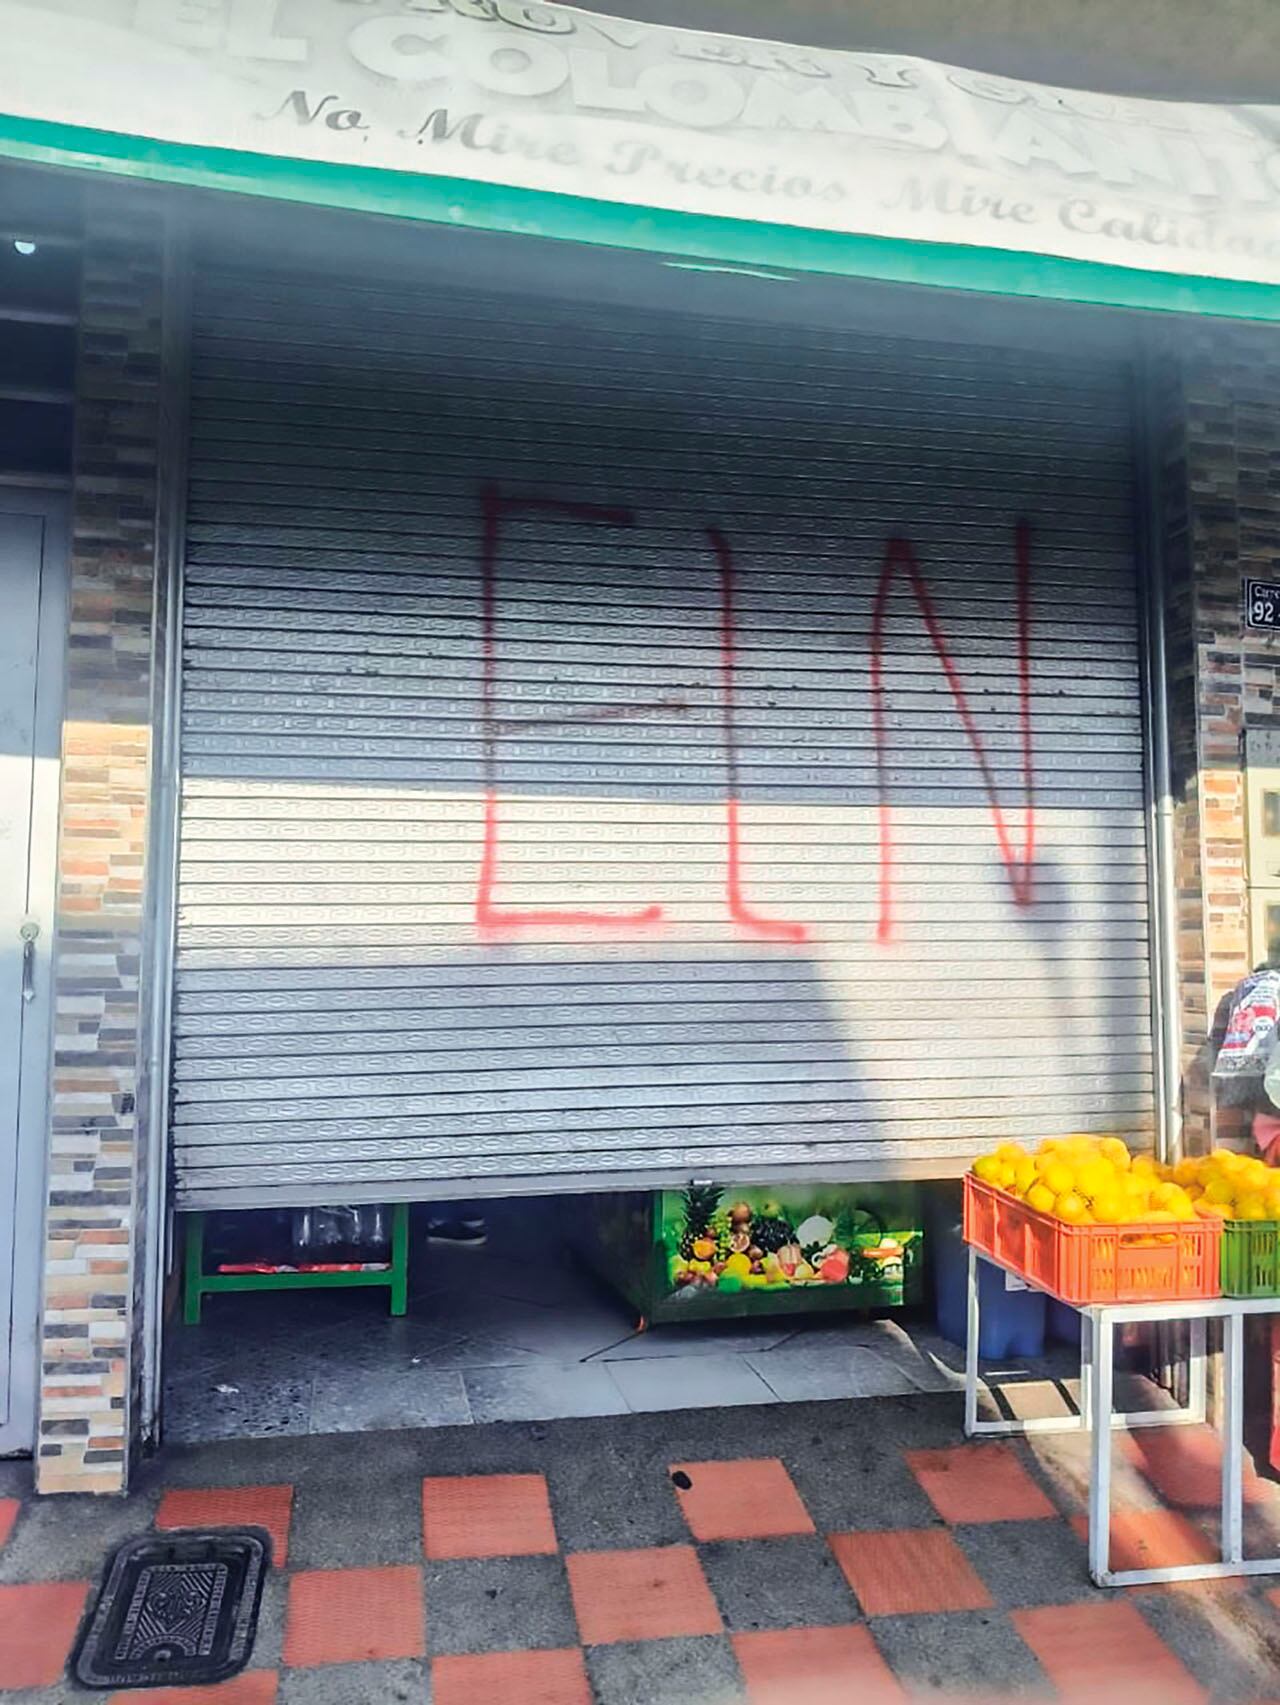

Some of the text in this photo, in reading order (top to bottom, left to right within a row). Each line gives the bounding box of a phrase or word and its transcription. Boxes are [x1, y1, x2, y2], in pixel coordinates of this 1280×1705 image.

[349, 12, 1280, 202] COLOMBIANIT
[396, 107, 581, 167] Mire
[602, 138, 848, 203] Precios
[880, 172, 1043, 226] Mire
[1253, 601, 1274, 622] 92
